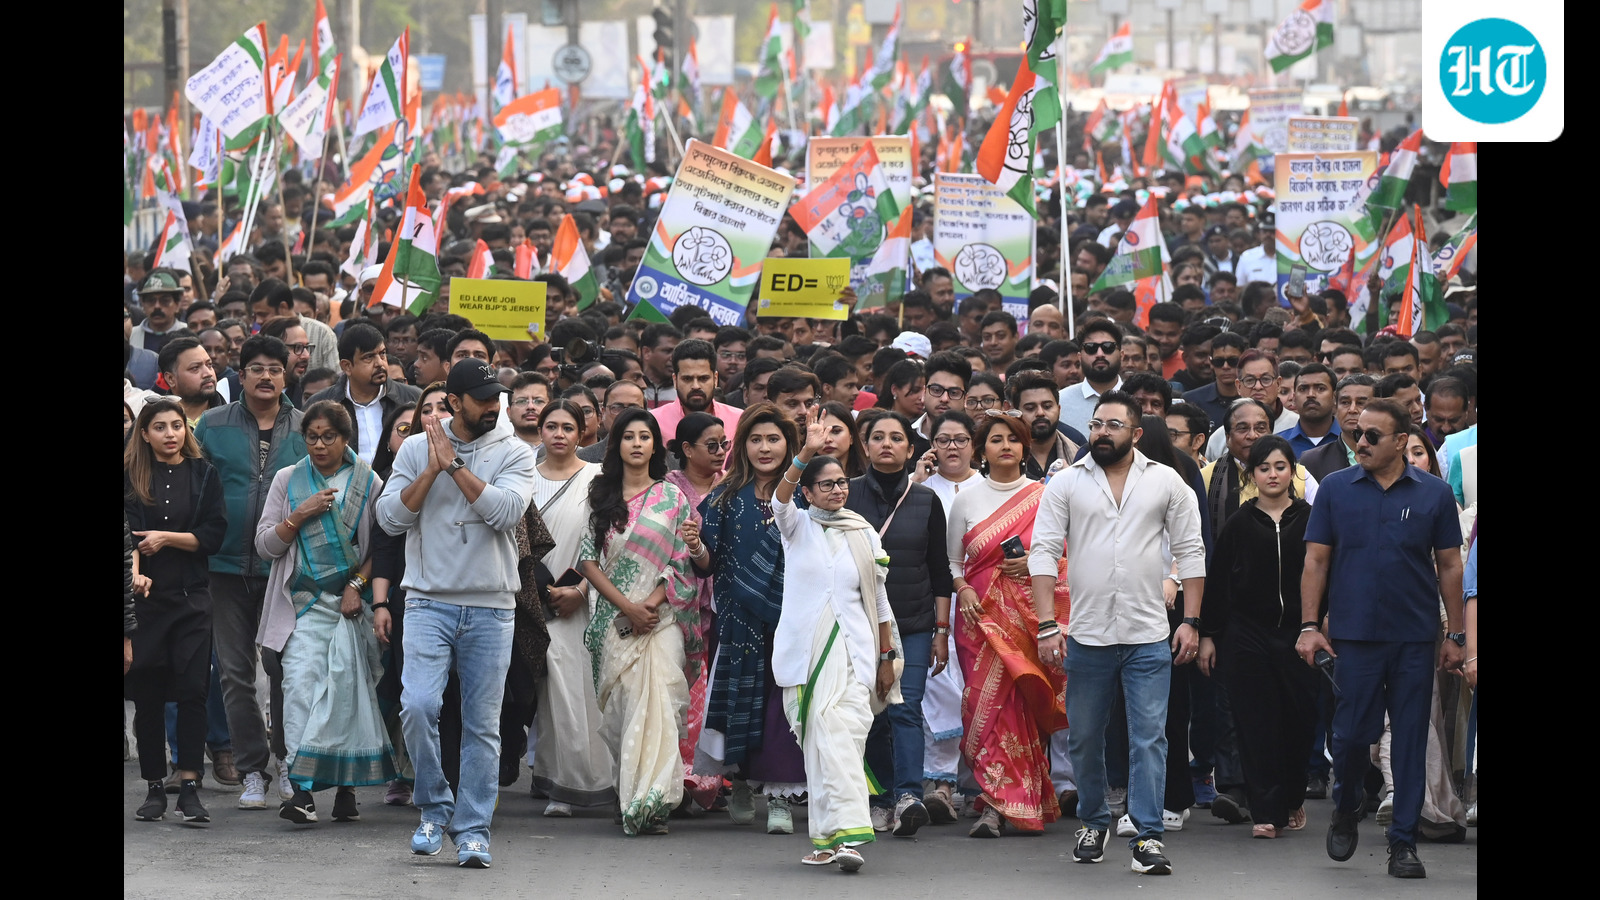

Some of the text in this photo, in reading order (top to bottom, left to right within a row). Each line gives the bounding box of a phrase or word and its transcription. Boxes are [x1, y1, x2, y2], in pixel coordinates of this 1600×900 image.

[1291, 156, 1361, 173] বাংলার উপর যে হামলা
[1290, 177, 1313, 192] বিজেপি
[1280, 202, 1302, 212] জনগণ
[1305, 202, 1314, 212] এর
[1318, 197, 1335, 211] সঠিক
[771, 274, 818, 291] ED=
